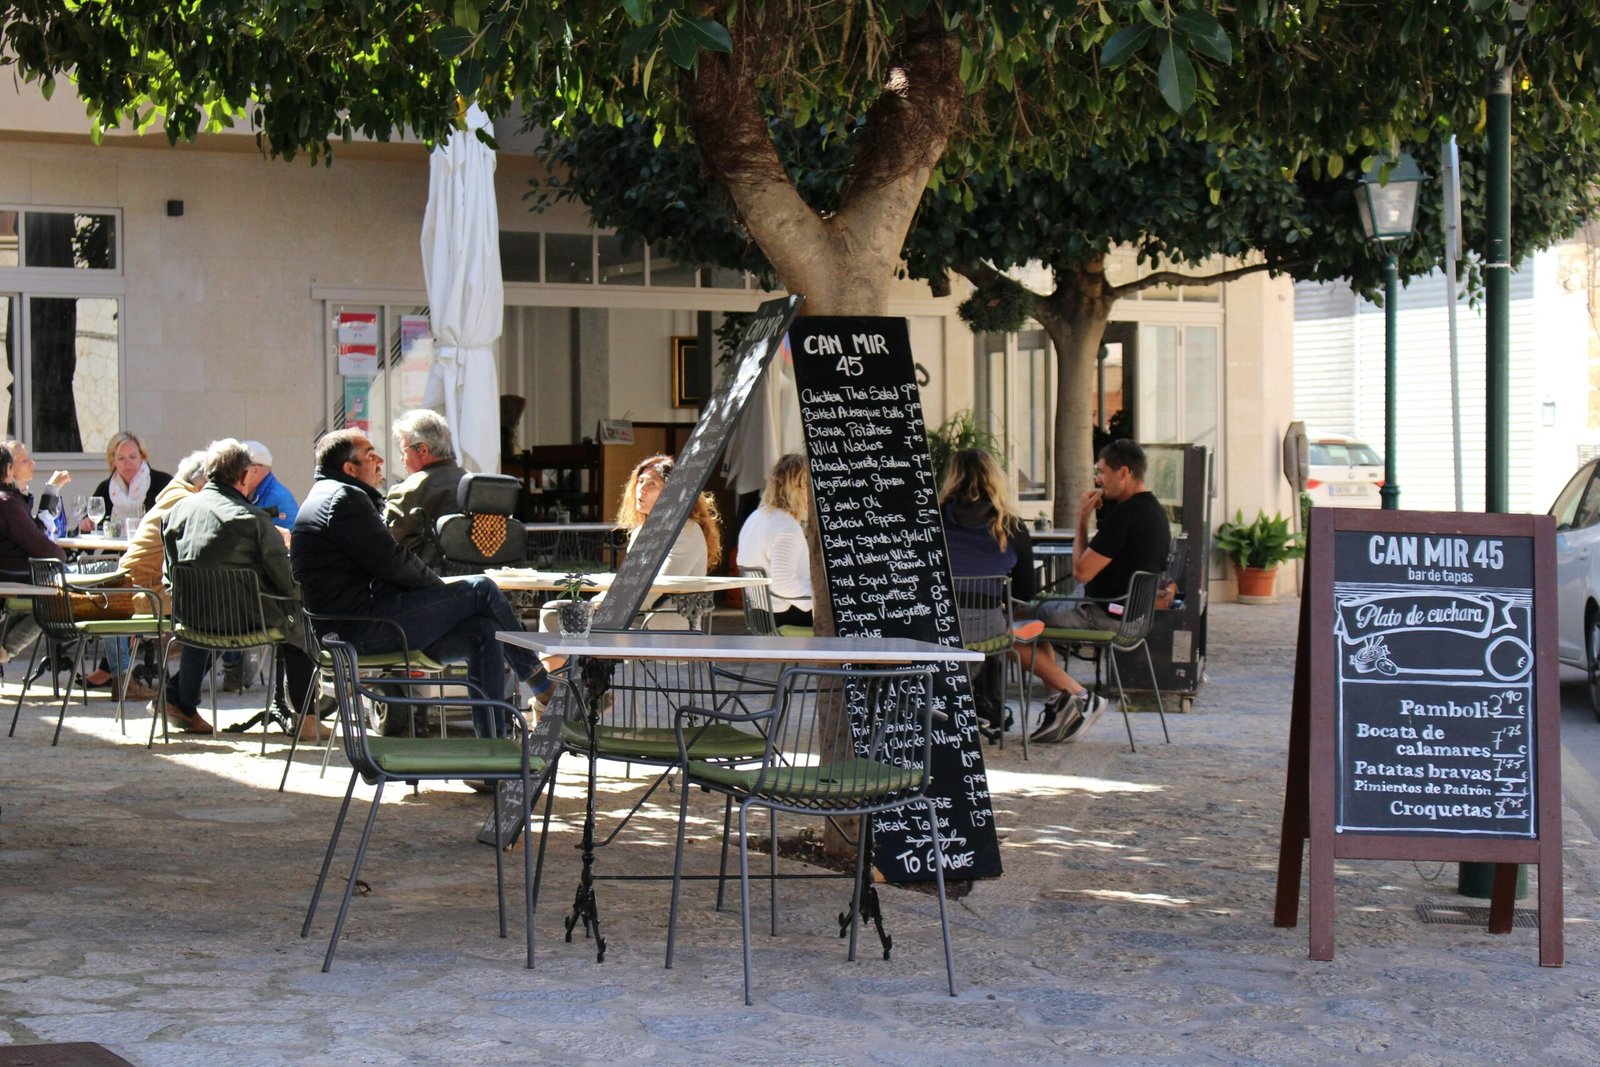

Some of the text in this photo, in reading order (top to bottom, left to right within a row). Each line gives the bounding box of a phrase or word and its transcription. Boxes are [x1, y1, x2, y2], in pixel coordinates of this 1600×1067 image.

[803, 333, 890, 355] CAN MIR
[835, 355, 864, 377] 45
[840, 386, 868, 400] Thai
[869, 386, 899, 400] Salad
[882, 405, 904, 419] Balls
[805, 423, 845, 438] Bravas
[846, 422, 892, 438] Potatoes
[809, 440, 838, 456] Wild
[843, 439, 884, 453] Nachos
[817, 496, 831, 512] Pa
[834, 497, 860, 511] amb
[862, 494, 882, 508] Oli
[823, 534, 855, 554] Baby
[1369, 534, 1504, 570] CAN MIR 45
[858, 574, 888, 591] Squid
[890, 573, 919, 591] Rings
[1408, 567, 1474, 584] bar de tapas
[832, 594, 857, 607] Fish
[1355, 601, 1484, 628] Plato de cuchara
[1400, 699, 1489, 718] Pamboli
[931, 730, 962, 749] Wings
[1356, 723, 1418, 739] Bocata
[1422, 724, 1445, 740] de
[1396, 741, 1491, 758] calamares
[1354, 760, 1425, 778] Patatas
[1428, 763, 1492, 781] bravas
[1354, 779, 1422, 794] Pimientos
[1424, 782, 1441, 794] de
[1443, 784, 1492, 796] Padrón
[1390, 800, 1493, 820] Croquetas
[896, 849, 921, 873] To
